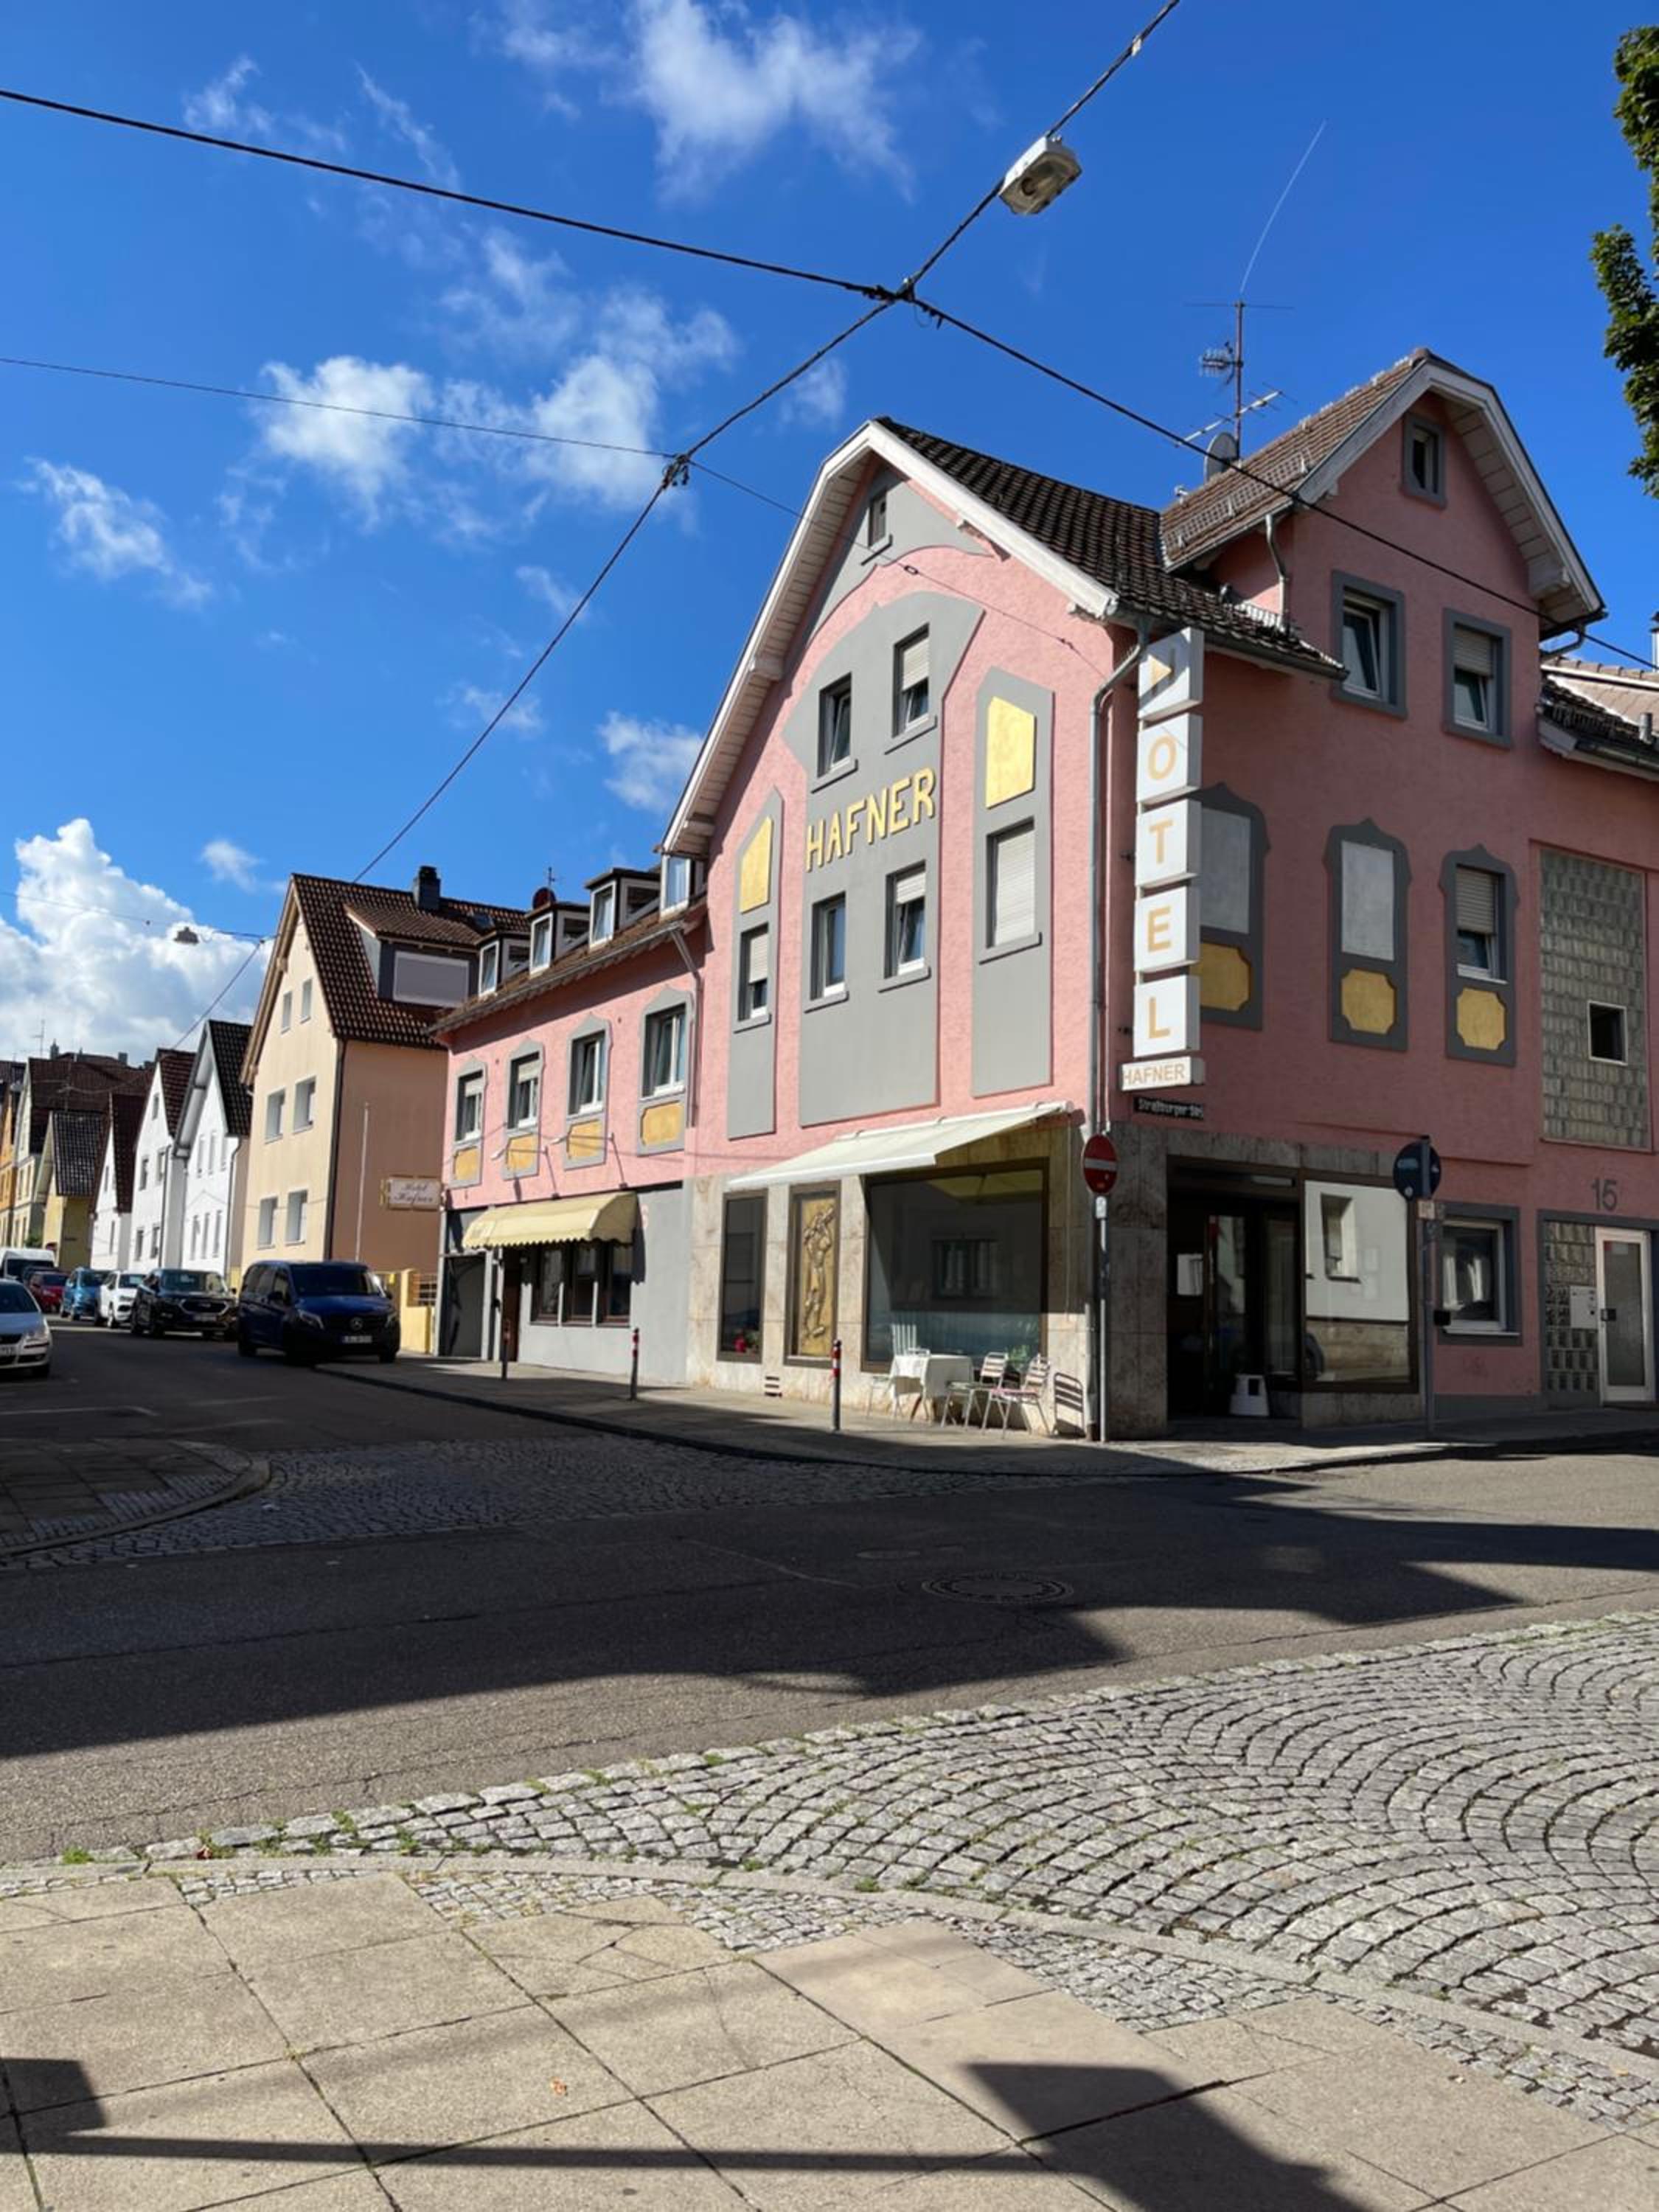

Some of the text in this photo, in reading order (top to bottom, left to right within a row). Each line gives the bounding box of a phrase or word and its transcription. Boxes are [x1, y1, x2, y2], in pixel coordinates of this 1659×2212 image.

[805, 767, 937, 874] HAFNER
[1146, 646, 1177, 1040] HOTEL
[1123, 1063, 1186, 1085] HAFNER
[1590, 1178, 1617, 1211] 15
